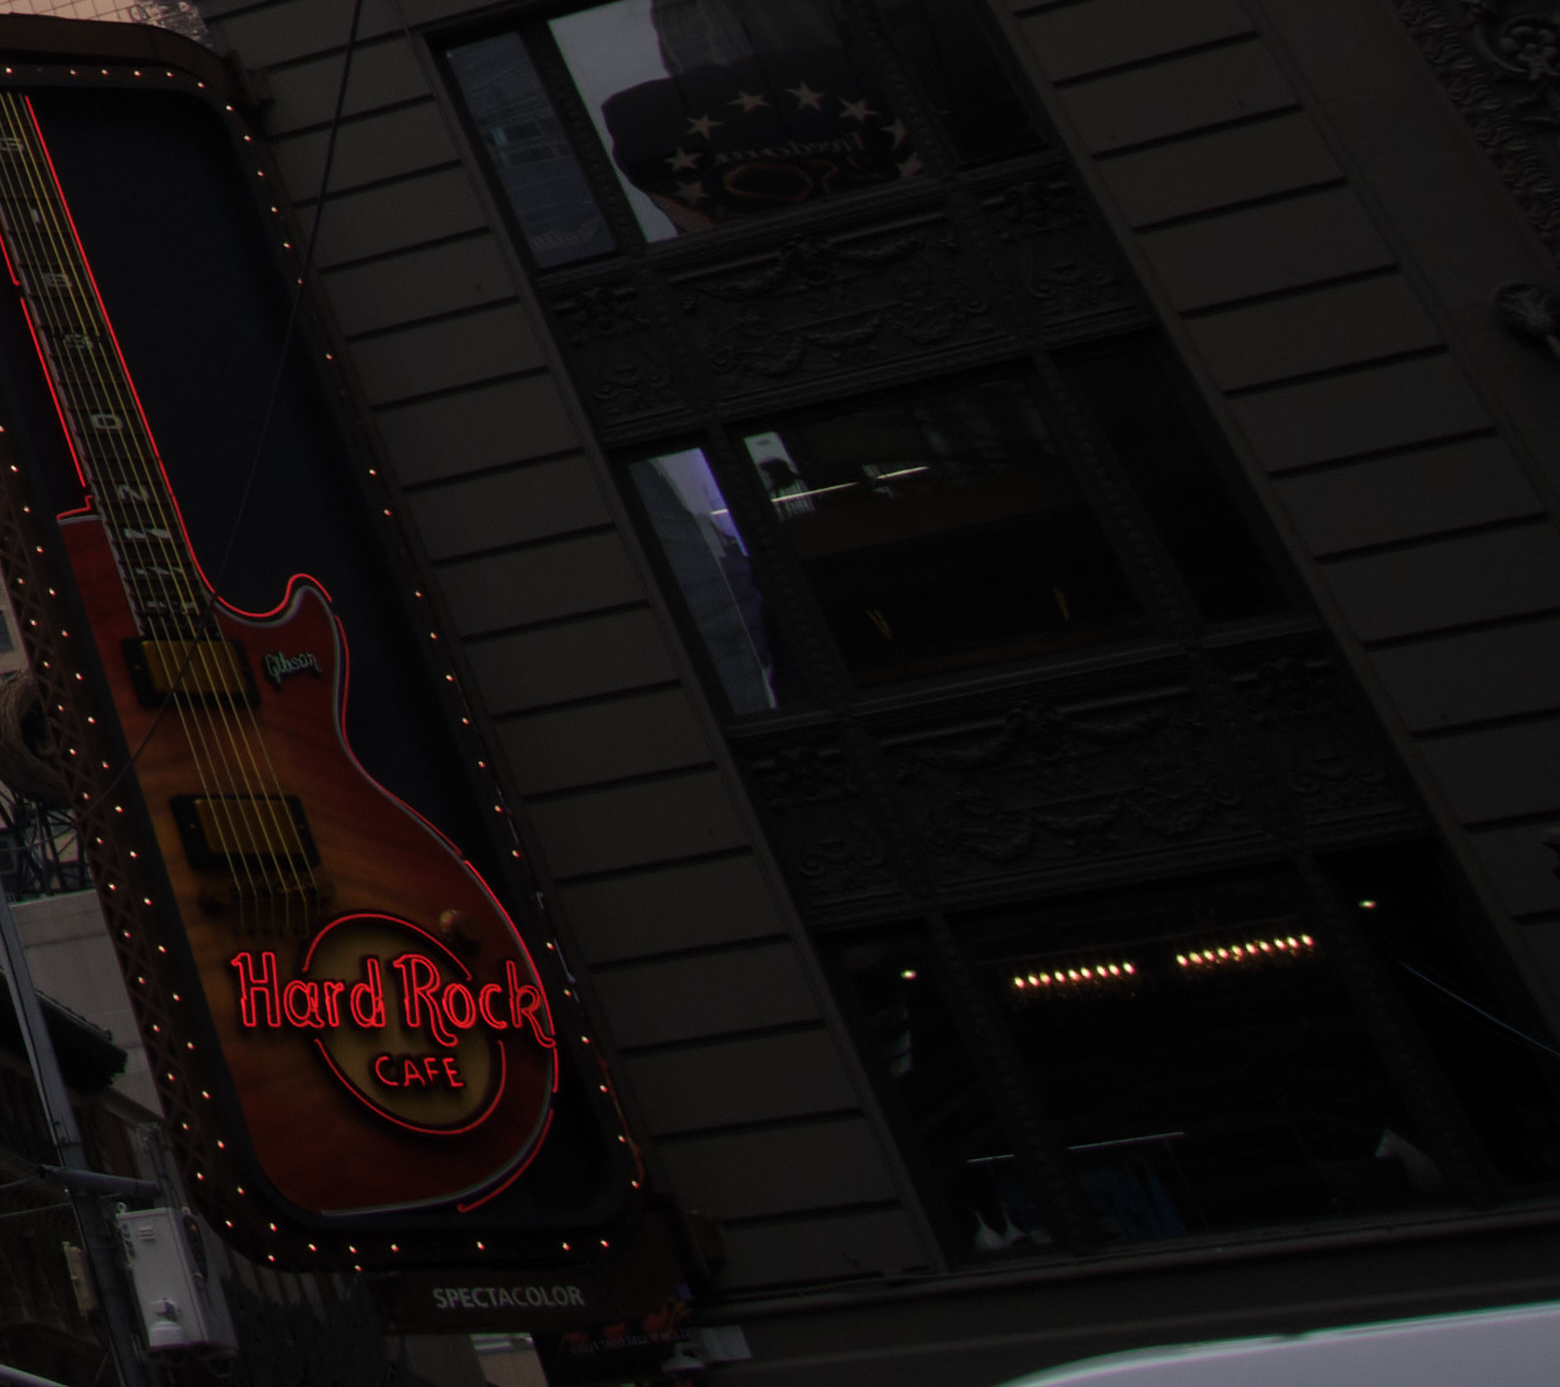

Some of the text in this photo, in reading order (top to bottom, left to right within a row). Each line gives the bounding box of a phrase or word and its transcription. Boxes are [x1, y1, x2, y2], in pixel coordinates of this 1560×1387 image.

[231, 951, 556, 1048] Hard Rock
[374, 1056, 465, 1088] CAFE
[432, 1285, 587, 1309] SPECTACOLOR
